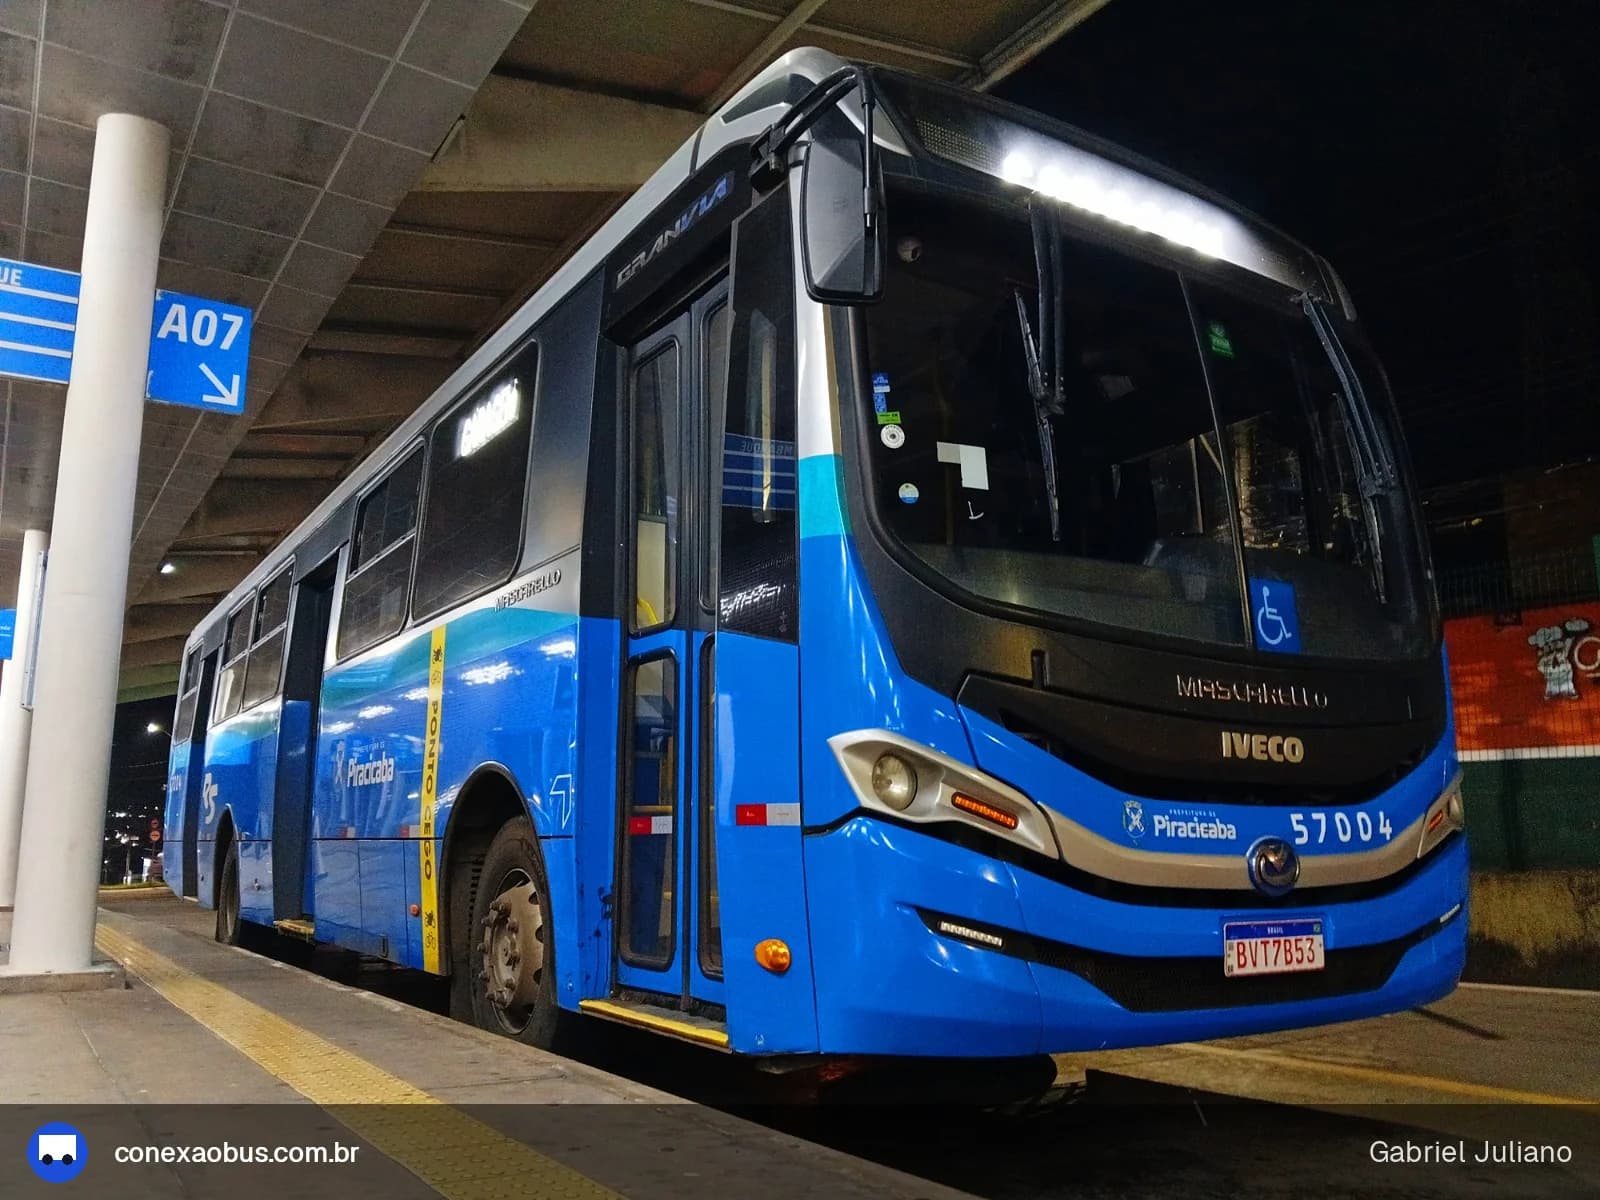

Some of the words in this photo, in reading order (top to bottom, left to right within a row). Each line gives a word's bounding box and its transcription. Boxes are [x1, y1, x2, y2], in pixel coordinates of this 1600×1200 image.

[157, 303, 244, 350] A07
[1176, 674, 1328, 708] MASCARELLO
[425, 700, 439, 795] PONTO
[1221, 731, 1304, 763] IVECO
[347, 751, 394, 788] Piracicaba
[423, 806, 433, 881] CEGO
[1153, 815, 1237, 840] Piracicaba
[1290, 811, 1393, 845] 57004
[1236, 938, 1316, 970] BVT7B53
